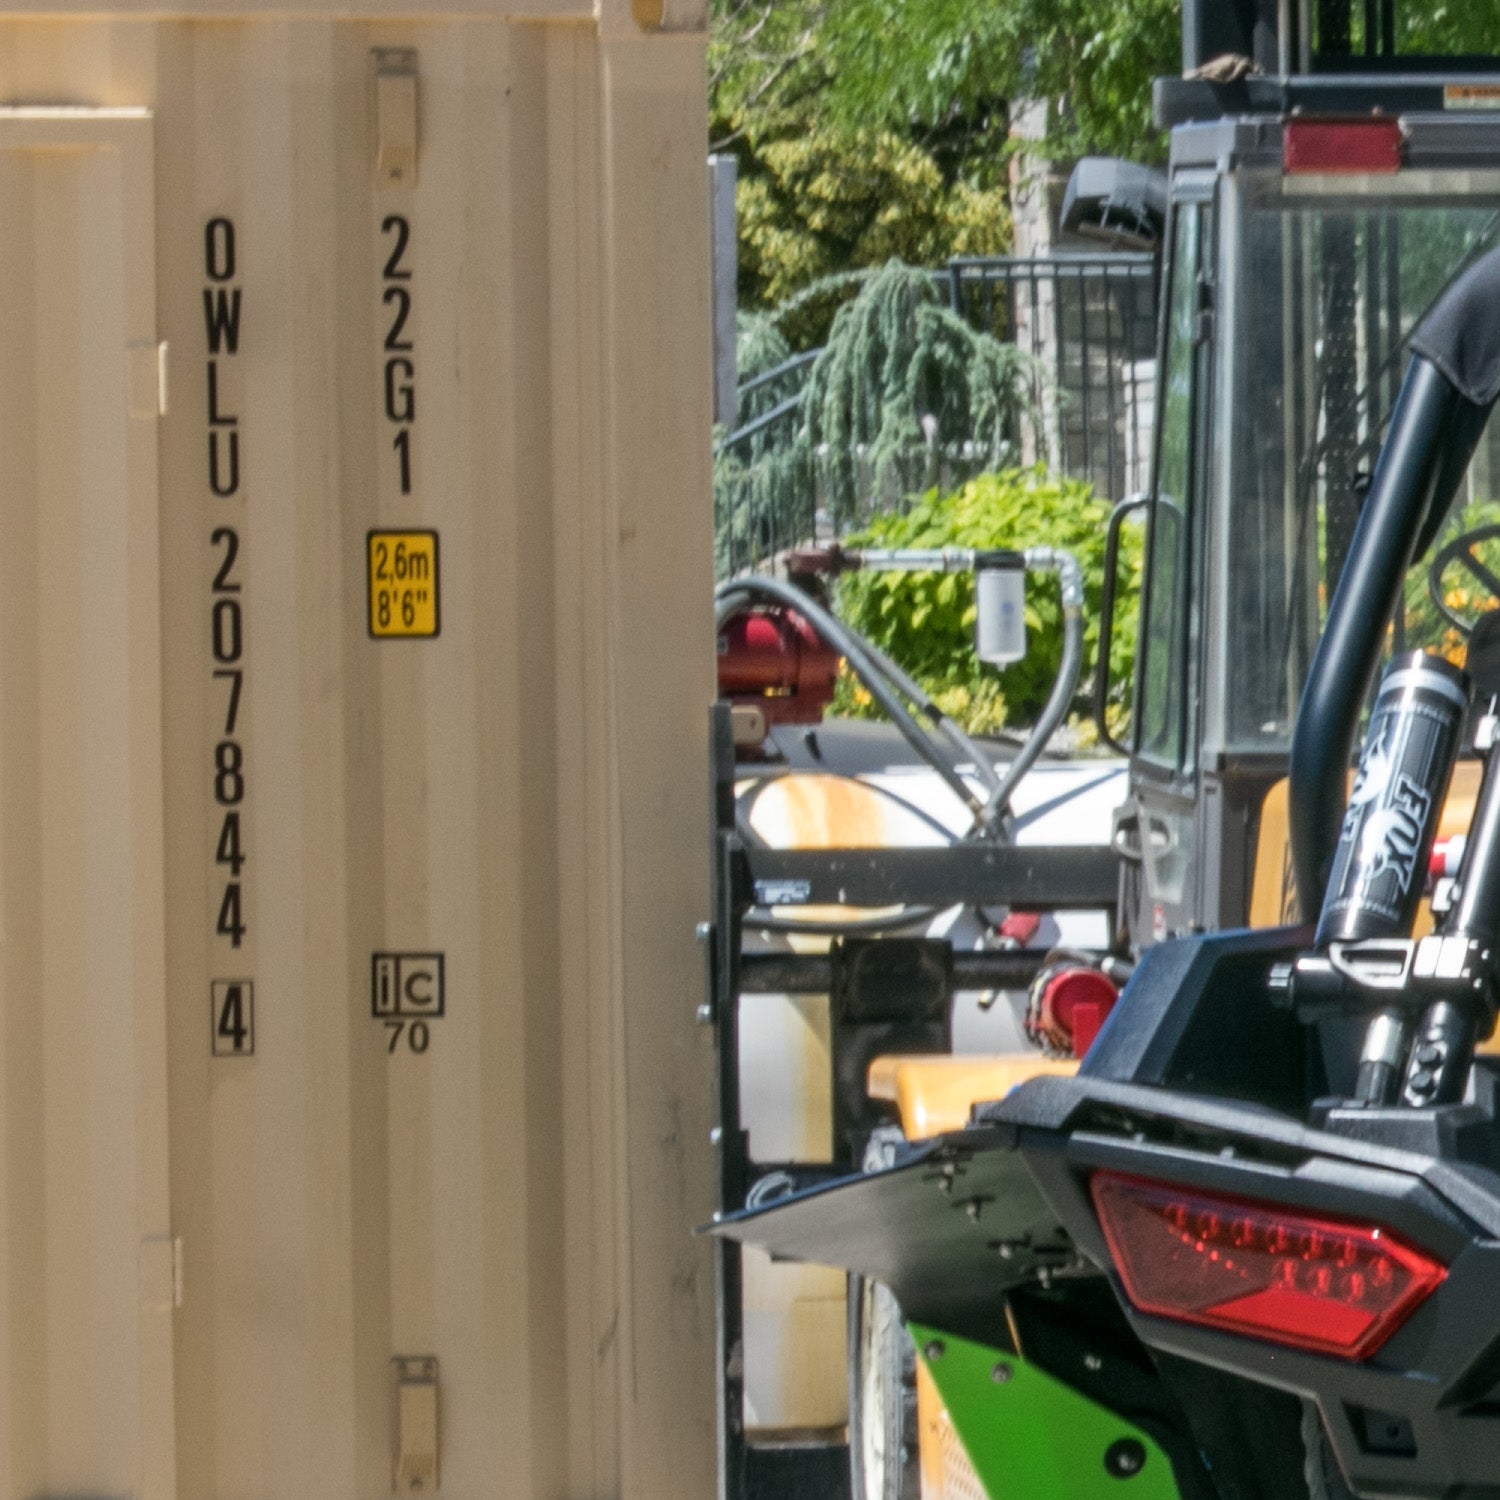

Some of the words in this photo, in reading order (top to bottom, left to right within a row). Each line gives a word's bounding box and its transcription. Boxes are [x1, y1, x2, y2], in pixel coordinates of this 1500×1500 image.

[204, 216, 241, 498] OWLU
[380, 214, 416, 495] 22G1
[375, 542, 430, 587] 2,6m
[210, 527, 247, 950] 207844
[217, 985, 248, 1052] 4
[383, 1021, 430, 1054] 70
